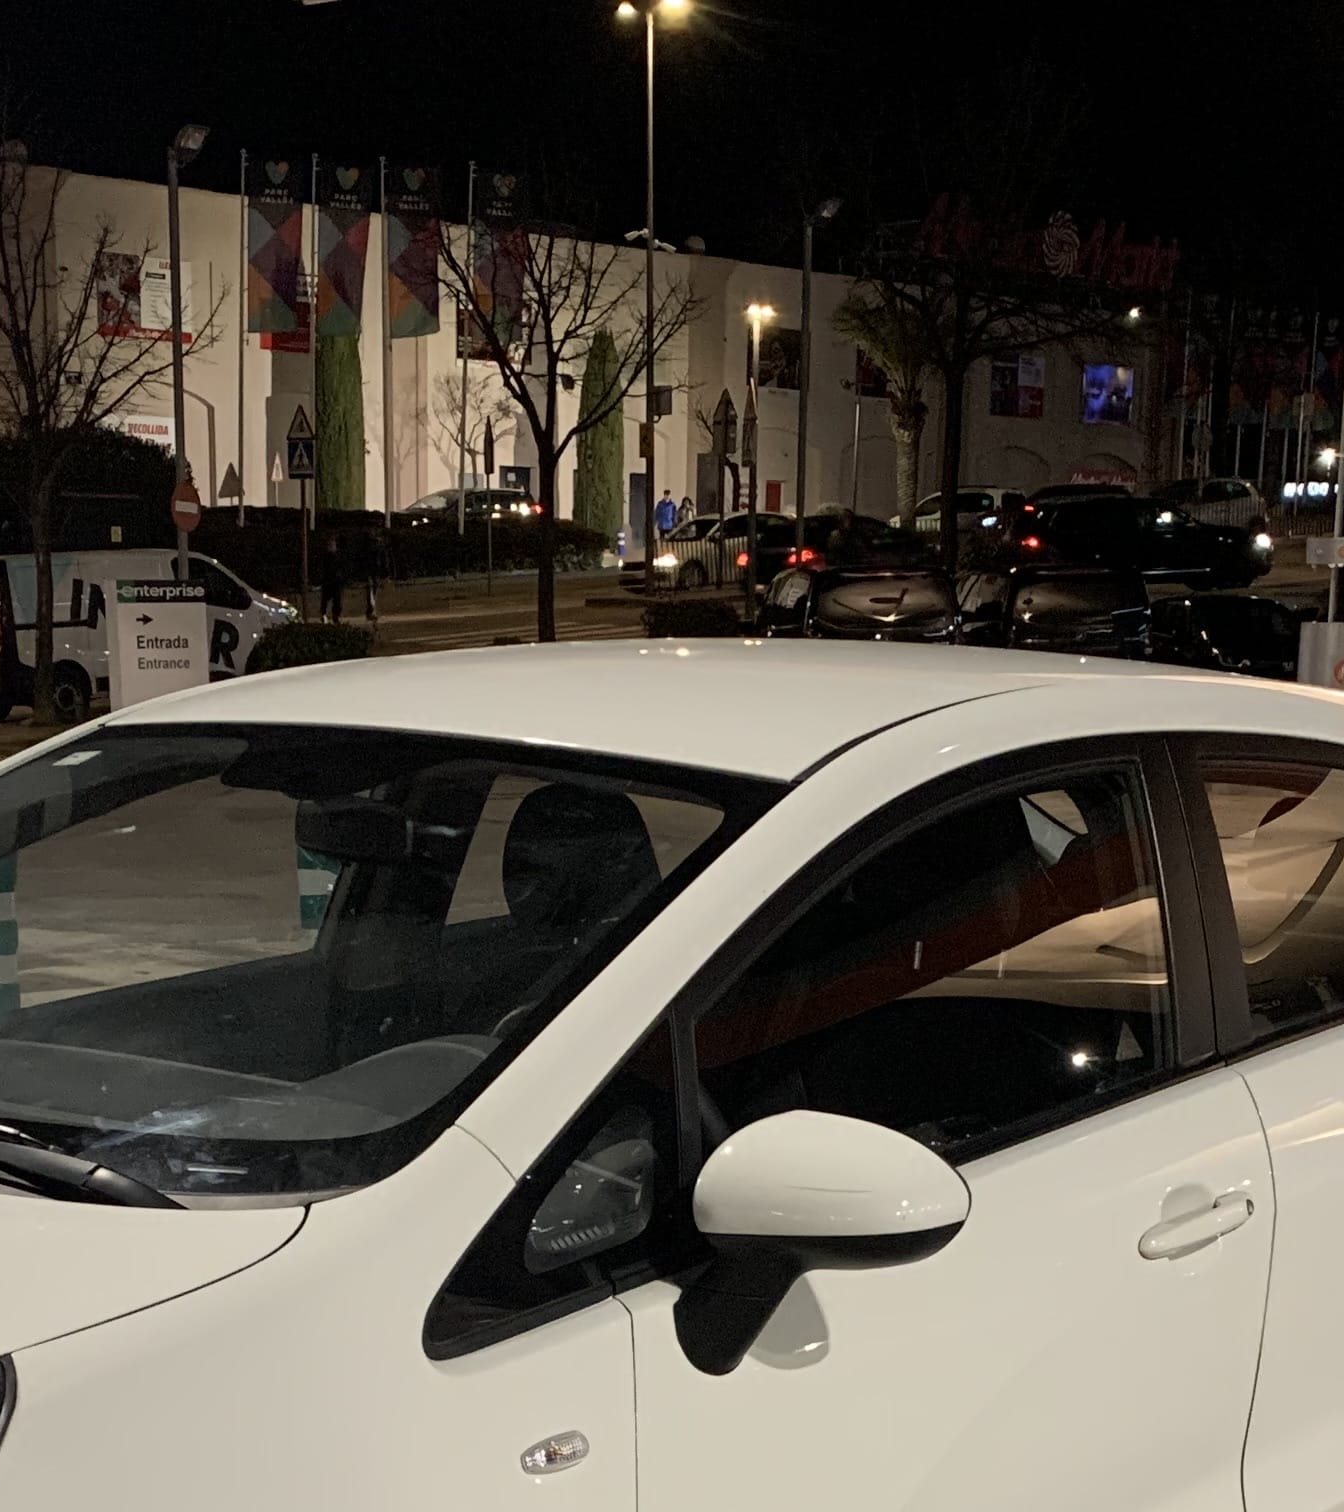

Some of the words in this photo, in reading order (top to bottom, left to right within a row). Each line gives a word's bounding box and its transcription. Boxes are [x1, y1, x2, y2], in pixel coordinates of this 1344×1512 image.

[118, 583, 205, 600] enterprise
[136, 635, 189, 650] Entrada
[137, 657, 191, 670] Entrance
